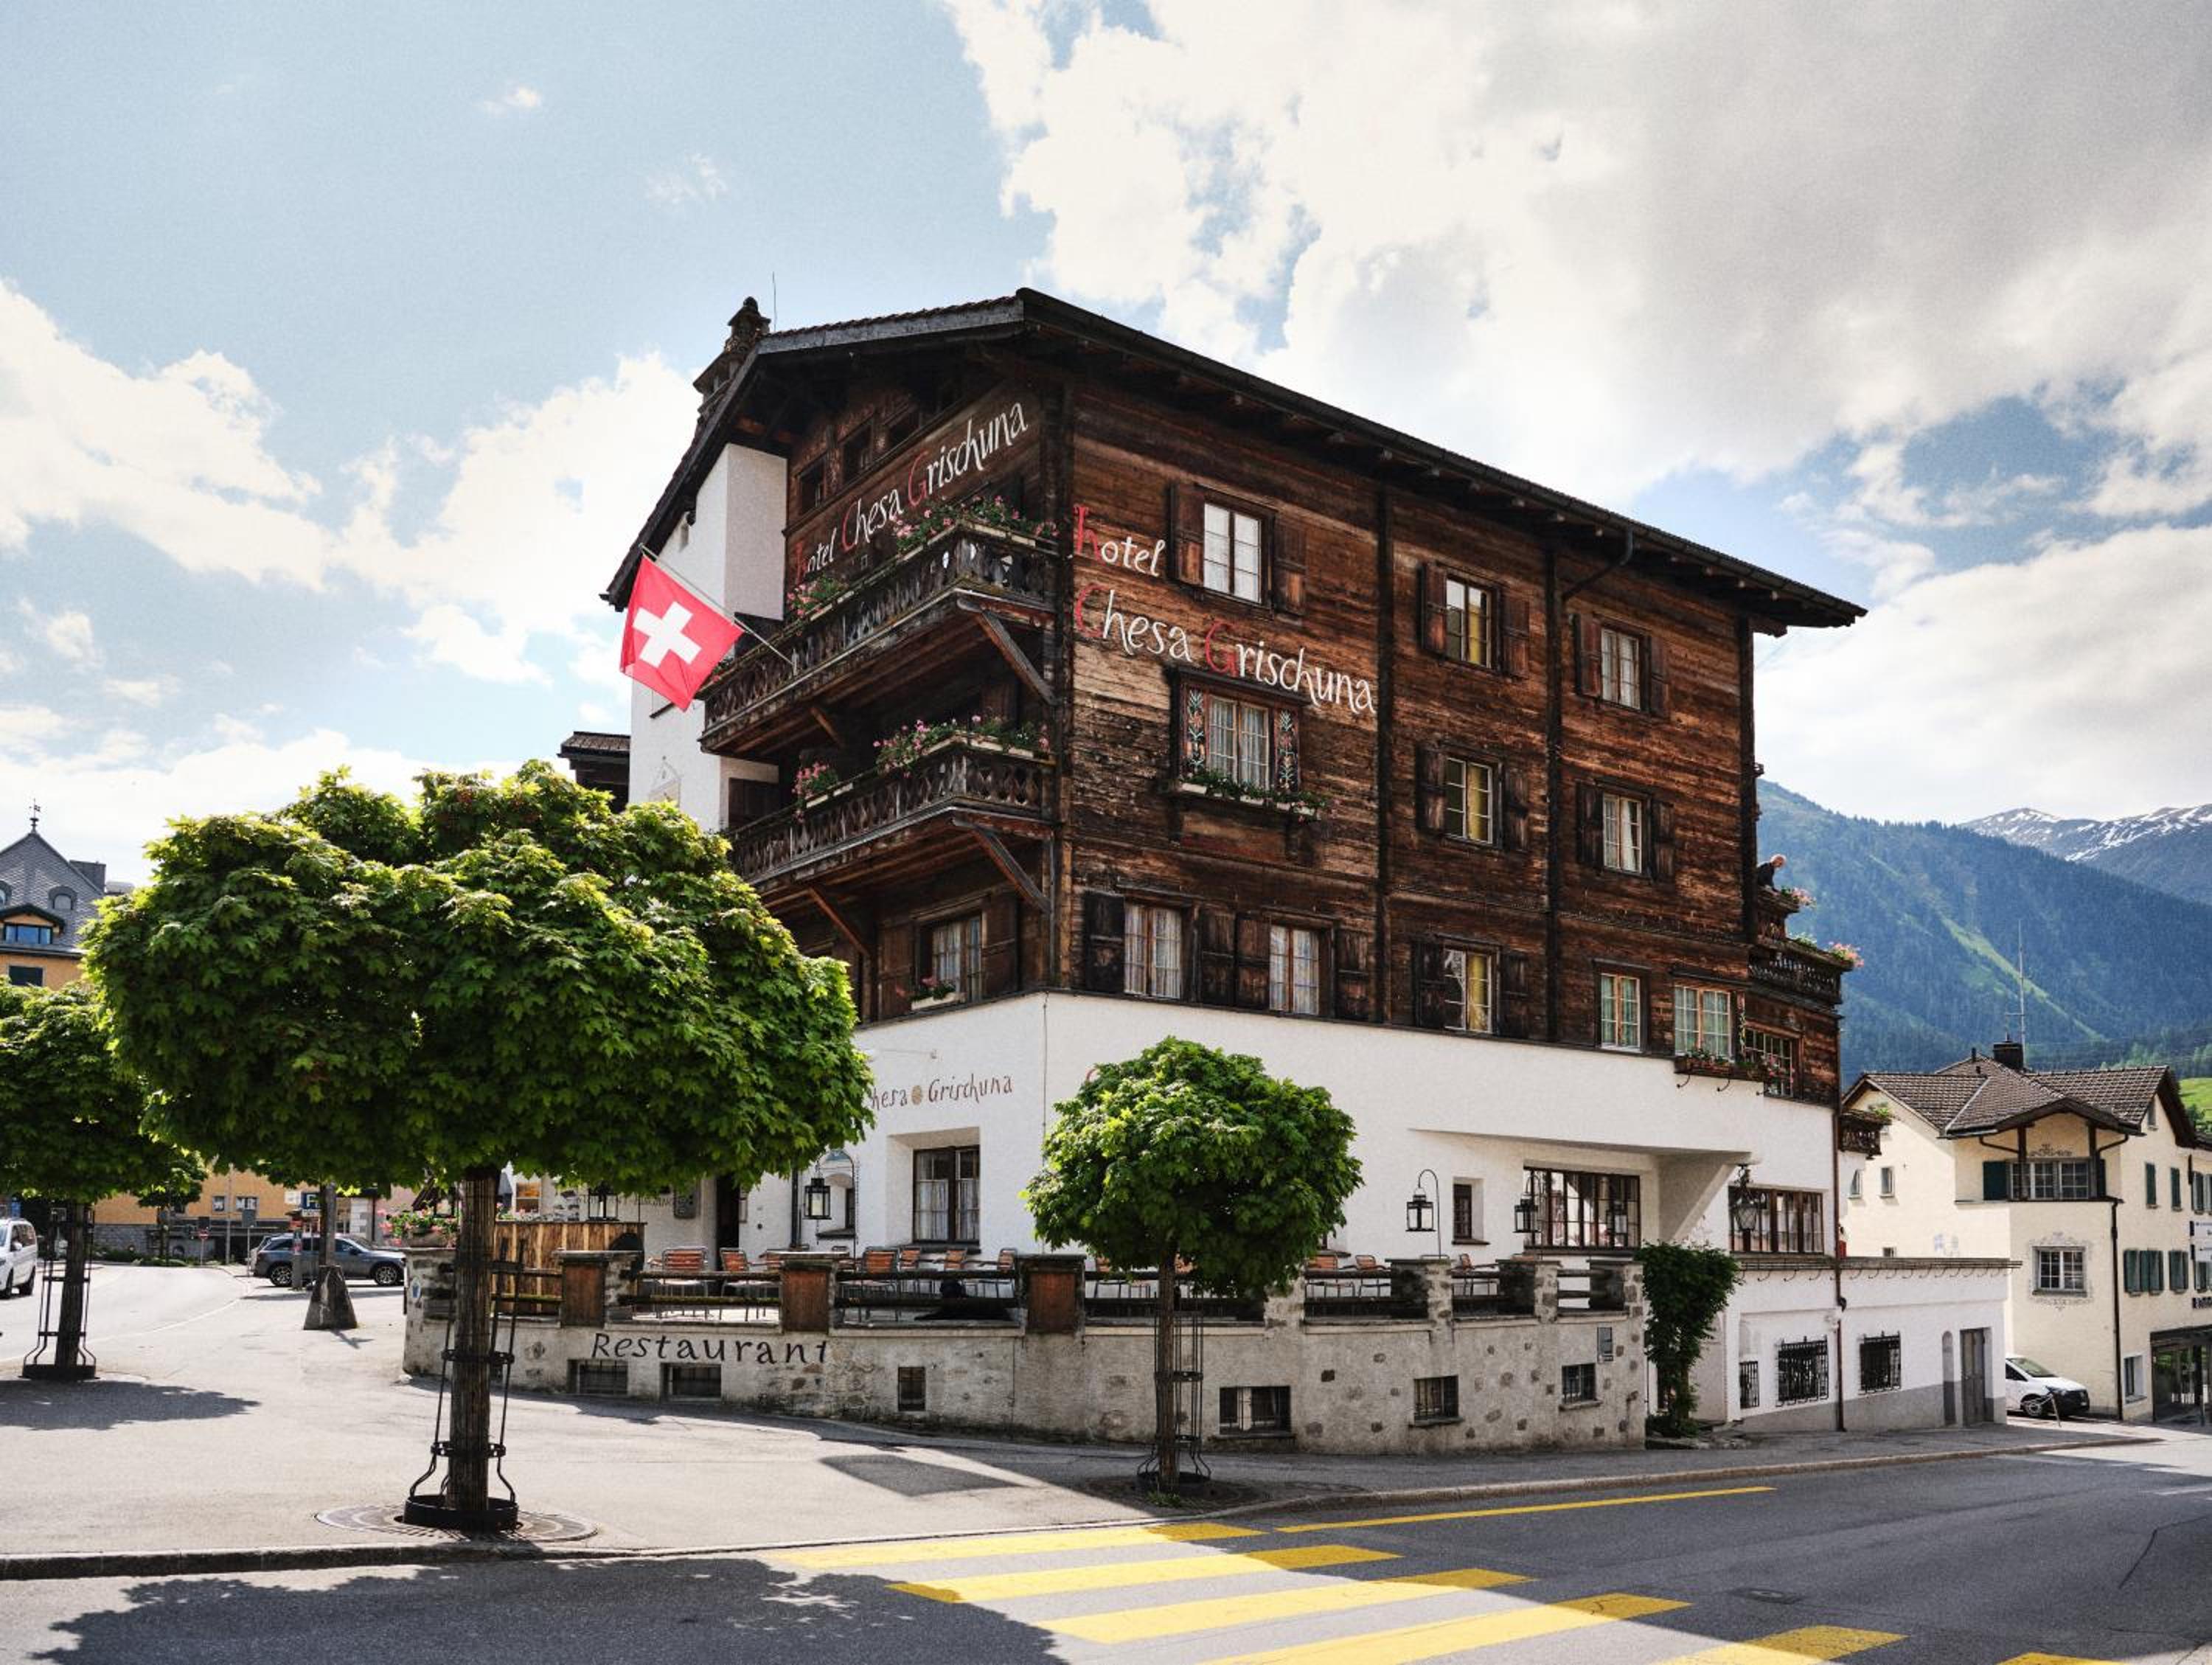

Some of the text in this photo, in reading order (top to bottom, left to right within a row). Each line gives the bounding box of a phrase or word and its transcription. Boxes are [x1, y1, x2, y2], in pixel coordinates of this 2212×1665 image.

[842, 488, 905, 552] Chesa
[908, 402, 1029, 507] Grischuna
[1073, 503, 1166, 577] hotel
[1074, 583, 1377, 715] Chesa Grischuna
[869, 1073, 1014, 1111] hesa Grischuna
[591, 1332, 827, 1364] Restaurant
